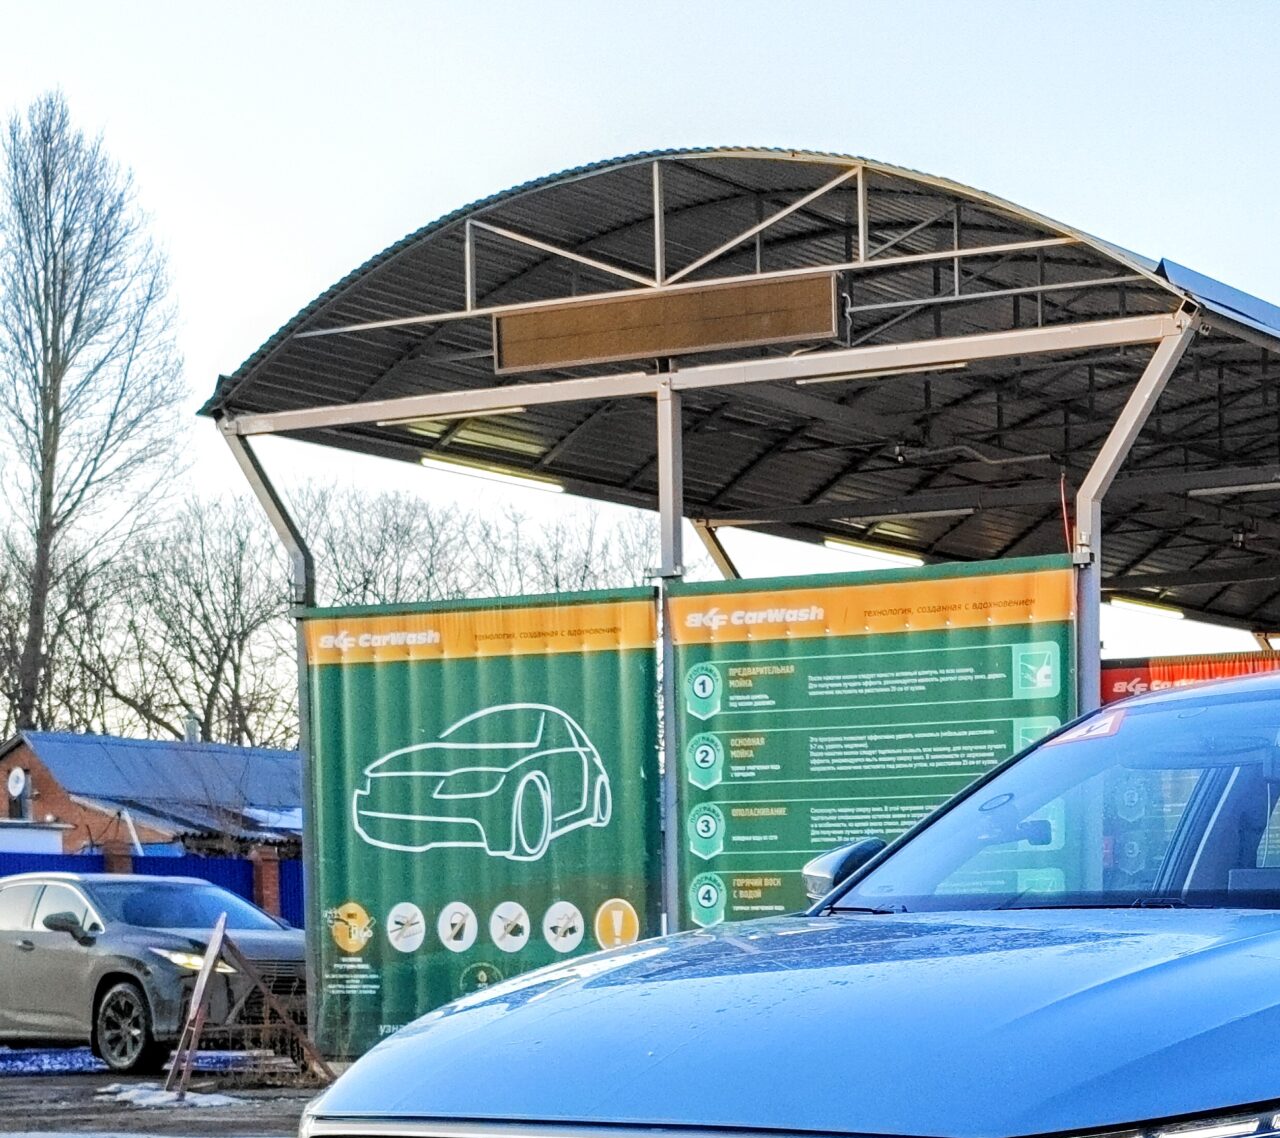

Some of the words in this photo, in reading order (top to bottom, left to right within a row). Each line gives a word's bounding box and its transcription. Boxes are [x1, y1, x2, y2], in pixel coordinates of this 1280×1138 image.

[730, 605, 825, 626] CarWash
[863, 607, 914, 618] технология,
[916, 604, 962, 615] созданная
[358, 630, 441, 648] CarWash
[698, 679, 706, 693] 1
[699, 749, 709, 763] 2
[701, 819, 711, 833] 3
[702, 888, 712, 903] 4
